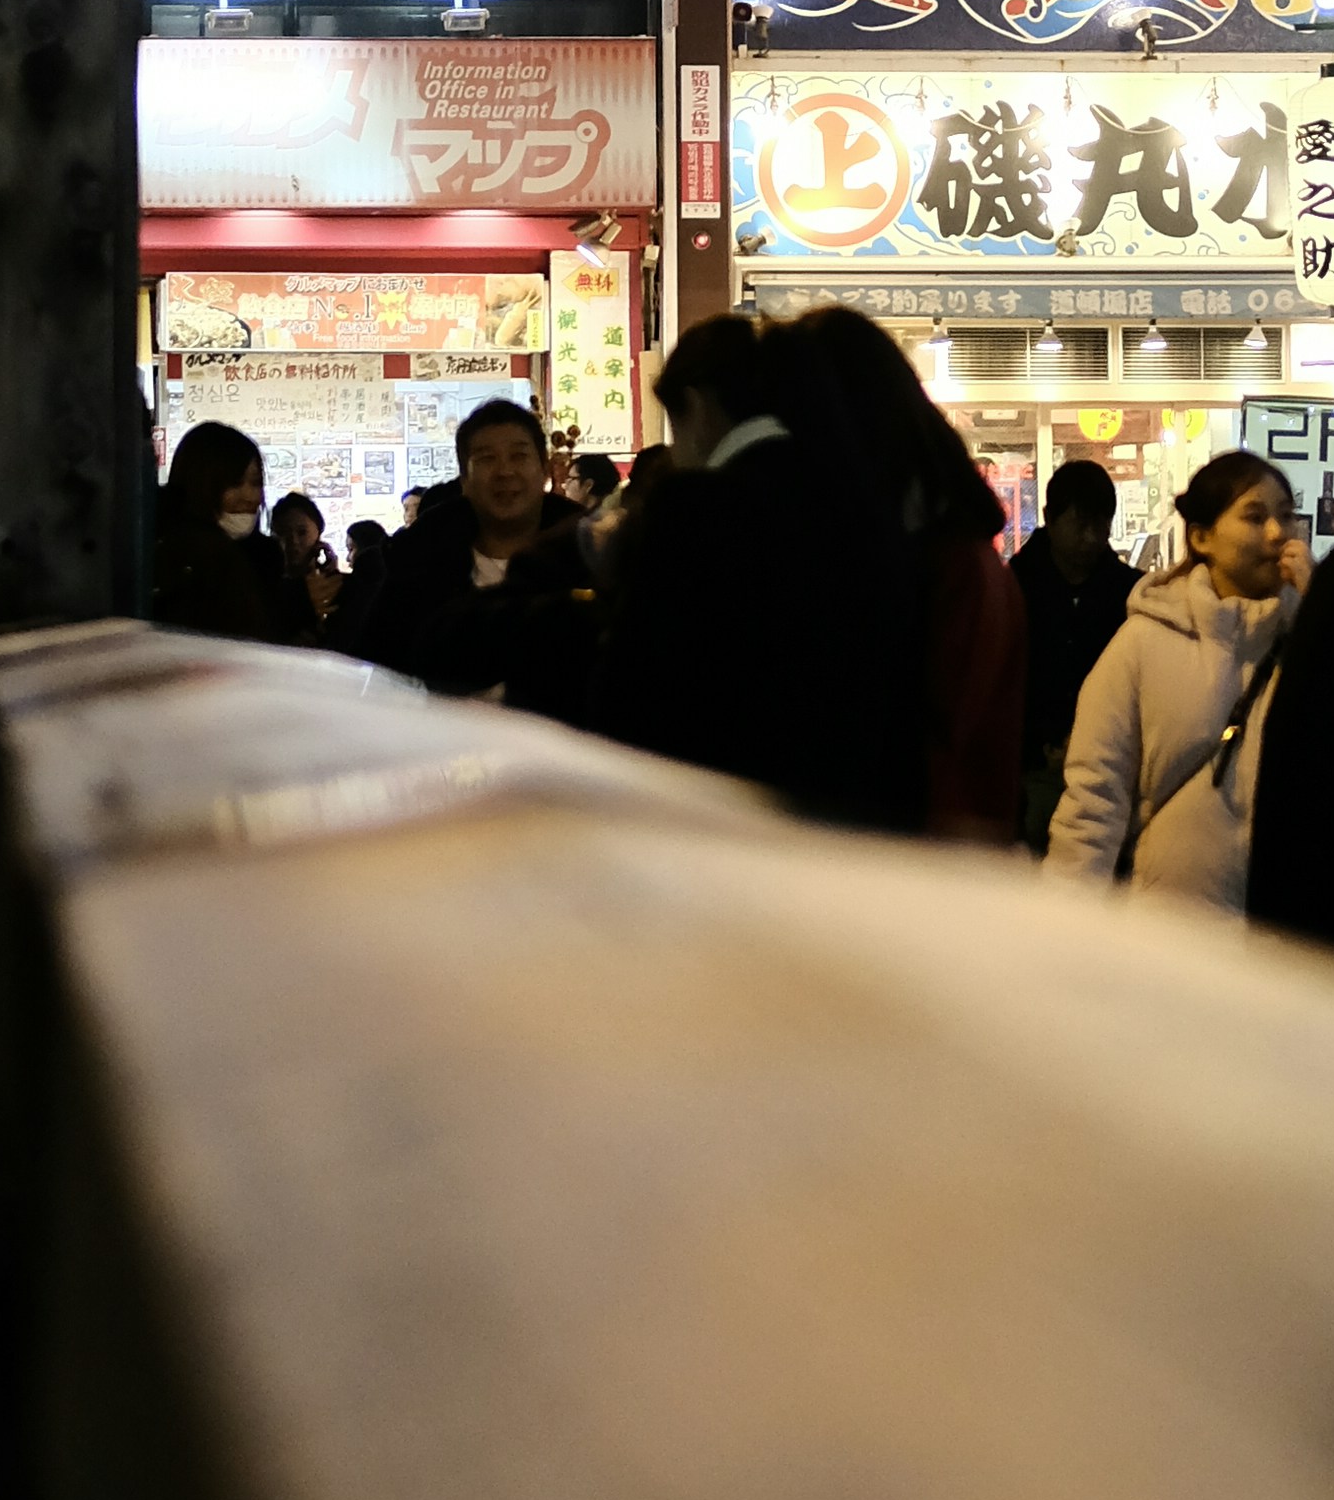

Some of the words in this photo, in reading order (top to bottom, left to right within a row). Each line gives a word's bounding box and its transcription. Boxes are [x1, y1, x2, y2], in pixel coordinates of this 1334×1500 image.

[423, 60, 547, 80] Information
[424, 80, 489, 99] Office
[495, 81, 515, 99] in
[433, 99, 549, 119] Restaurant
[691, 70, 710, 137] 防犯カメラ作動中
[403, 120, 599, 194] マップ
[574, 273, 614, 292] 無料
[1181, 288, 1234, 314] 電話
[557, 309, 579, 425] 観光案内
[603, 326, 626, 410] 道案内
[188, 383, 241, 404] 점심은
